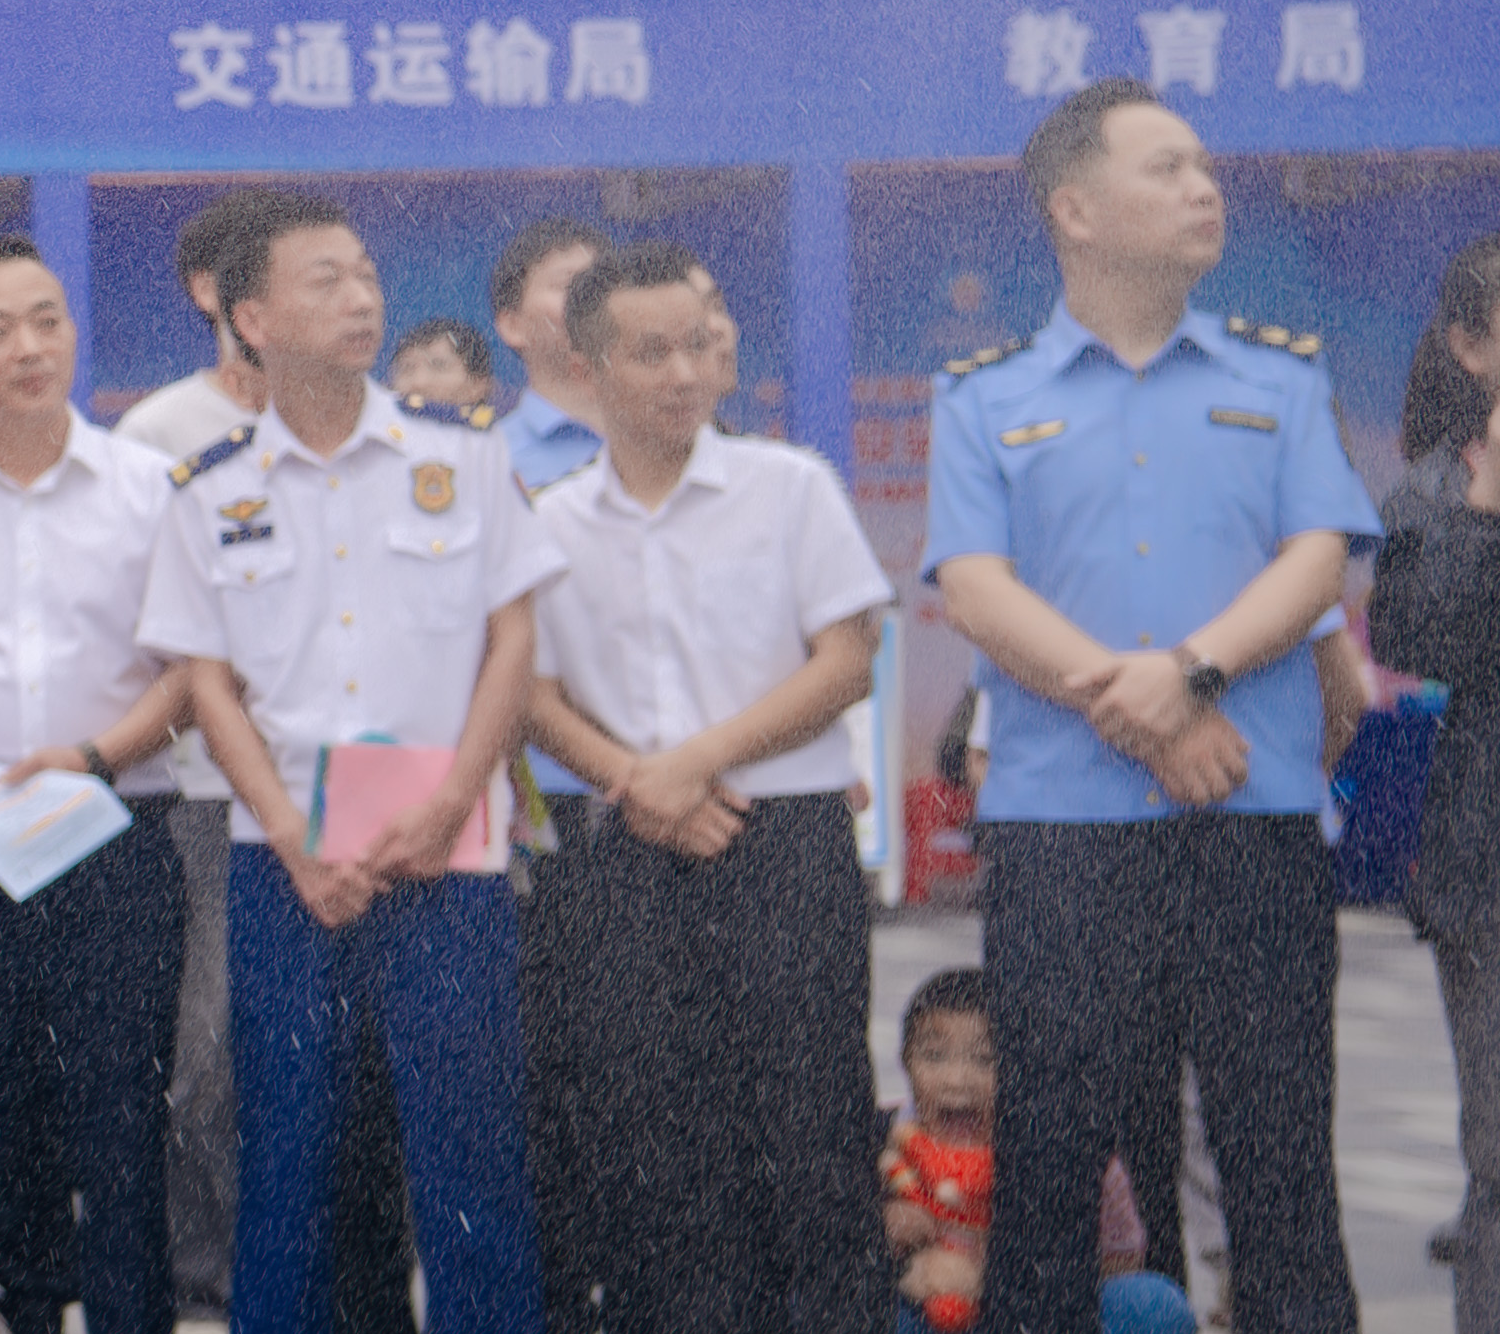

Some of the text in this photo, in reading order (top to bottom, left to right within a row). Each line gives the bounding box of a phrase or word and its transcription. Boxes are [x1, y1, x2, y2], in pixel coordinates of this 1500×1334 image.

[171, 17, 651, 109] 交通运输局
[1005, 0, 1366, 98] 教育局
